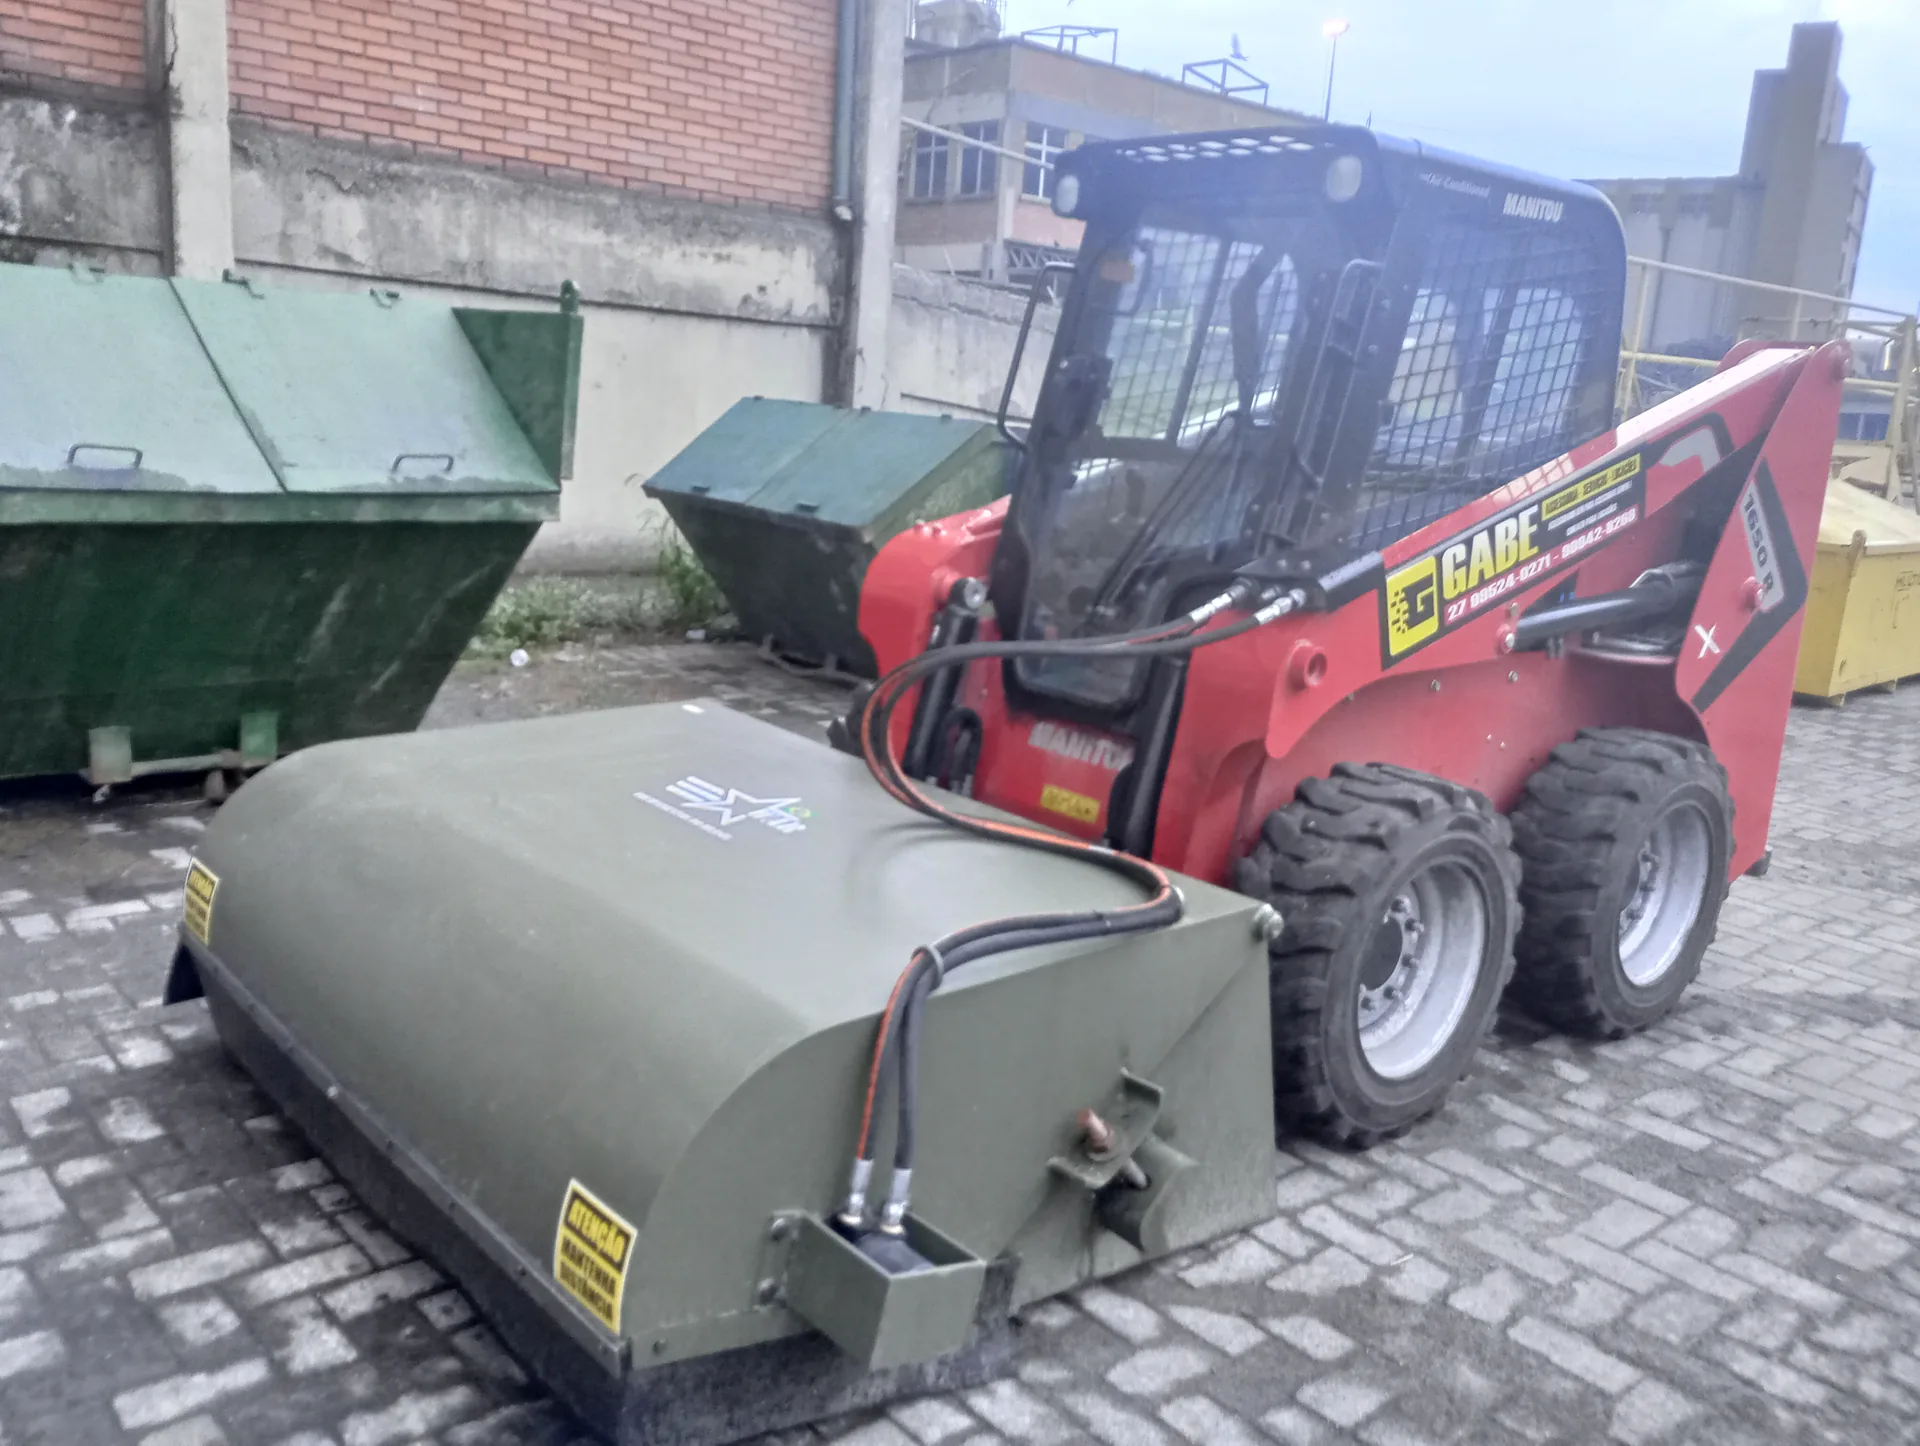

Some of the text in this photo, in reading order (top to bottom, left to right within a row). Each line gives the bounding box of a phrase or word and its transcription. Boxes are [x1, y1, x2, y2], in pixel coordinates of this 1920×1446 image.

[1503, 192, 1564, 223] MANITOU
[1442, 505, 1539, 600] GABE
[1448, 598, 1467, 621] 27
[567, 1198, 626, 1264] ATENÇÃO
[561, 1235, 617, 1296] MANTENHA
